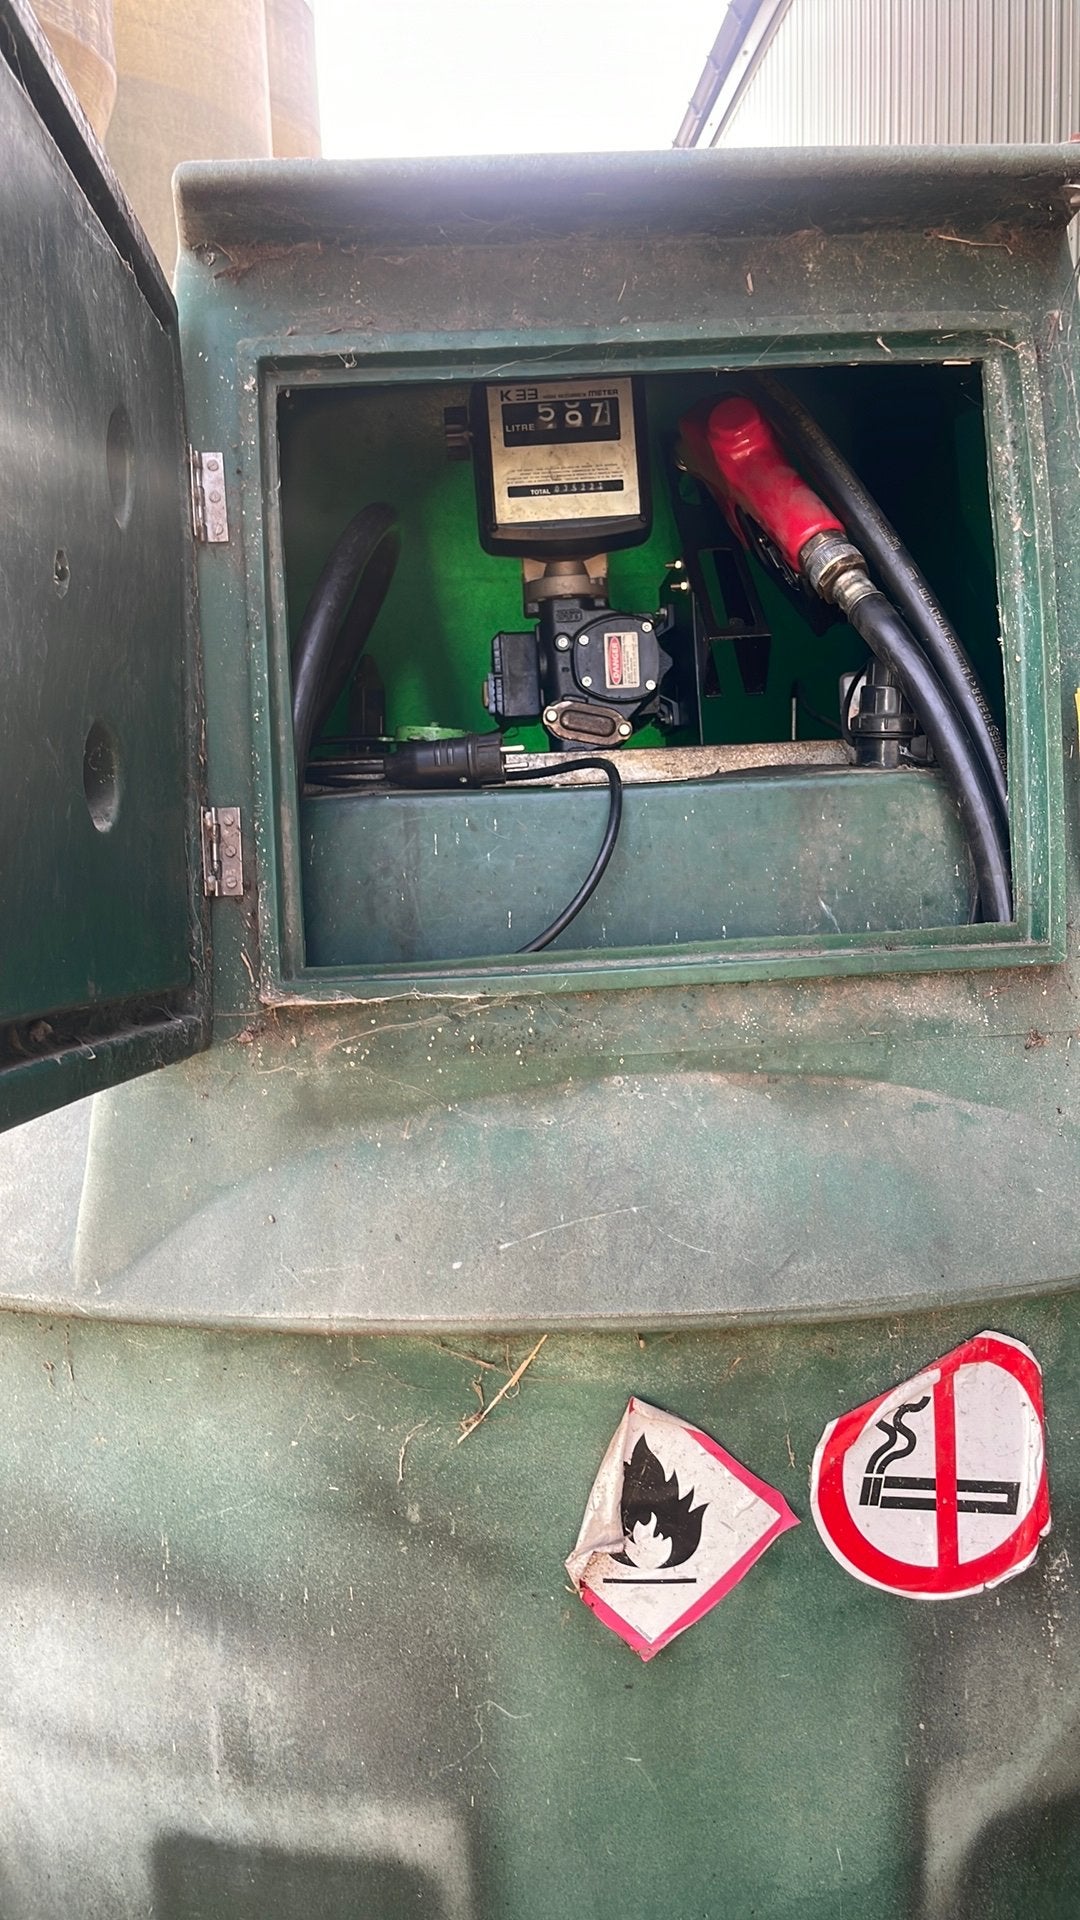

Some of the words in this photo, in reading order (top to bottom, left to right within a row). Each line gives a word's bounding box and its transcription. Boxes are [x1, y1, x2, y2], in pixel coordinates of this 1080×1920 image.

[505, 423, 535, 432] LITRE
[530, 488, 551, 496] TOTAL
[930, 606, 945, 627] ITALY
[946, 636, 963, 659] MADE
[611, 643, 619, 679] DANGER
[983, 713, 993, 723] 10
